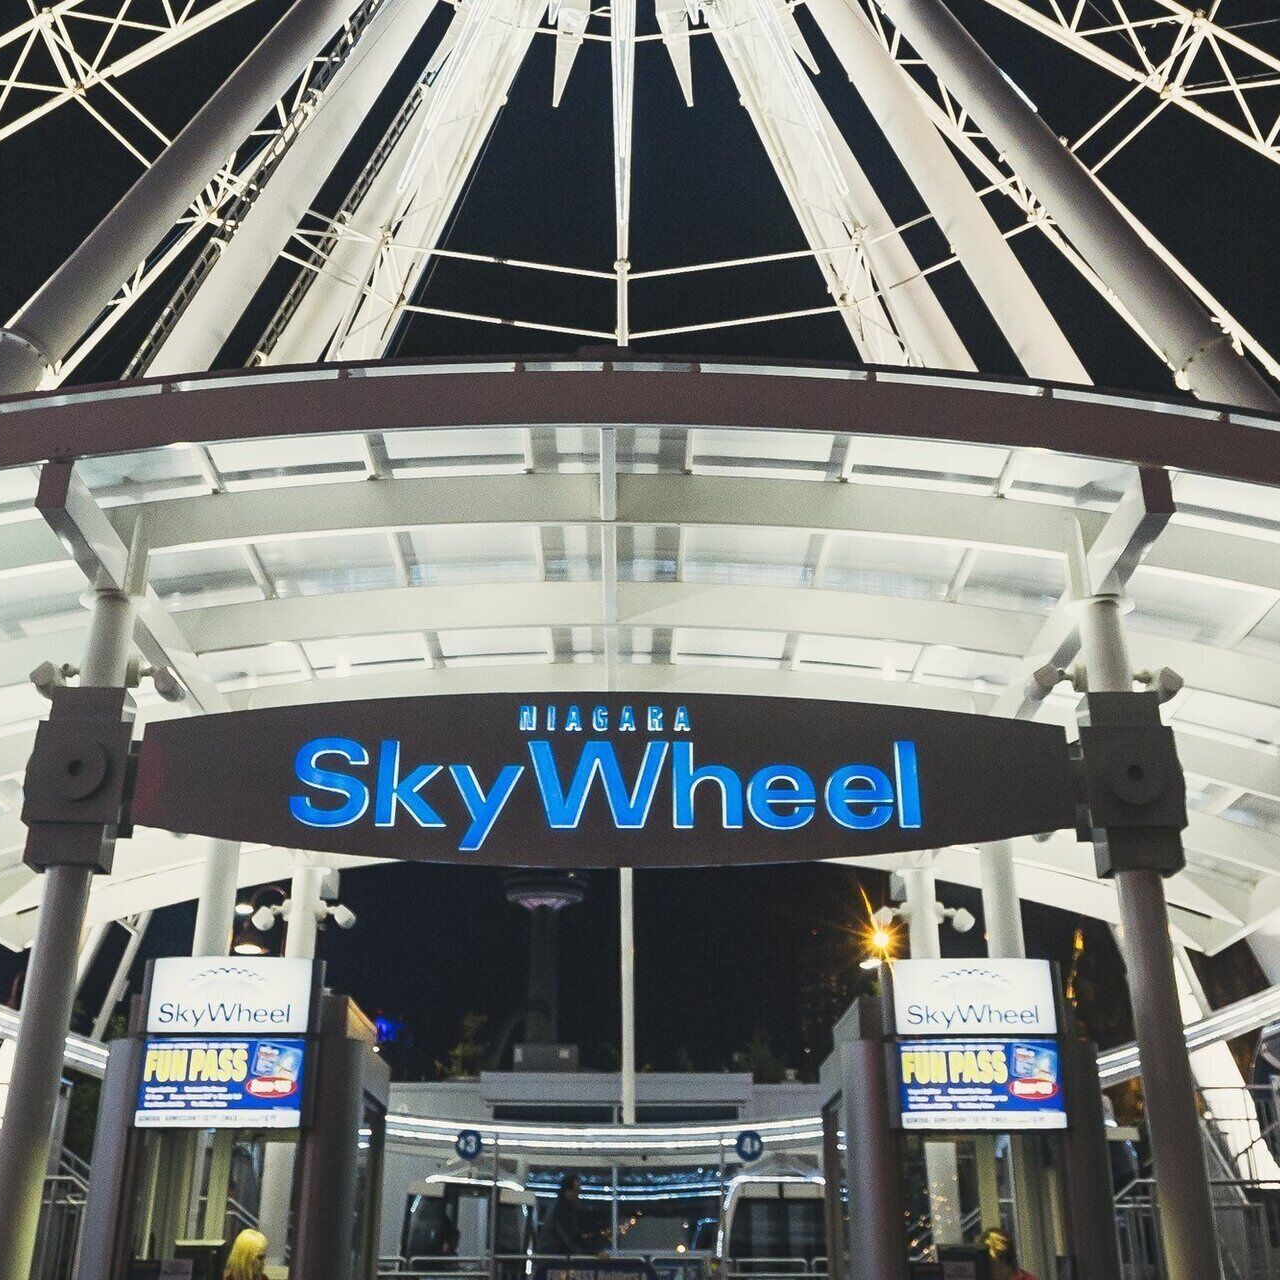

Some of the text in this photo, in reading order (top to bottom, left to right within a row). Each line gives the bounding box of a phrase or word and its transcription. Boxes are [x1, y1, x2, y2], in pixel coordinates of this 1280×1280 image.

[519, 704, 692, 732] NIAGARA
[289, 737, 923, 852] SkyWheel
[158, 1002, 291, 1028] SkyWheel
[907, 1004, 1040, 1029] SkyWheel
[143, 1049, 188, 1083] FUN
[189, 1048, 249, 1083] PASS
[900, 1051, 947, 1085] FUN
[948, 1050, 1008, 1085] PASS
